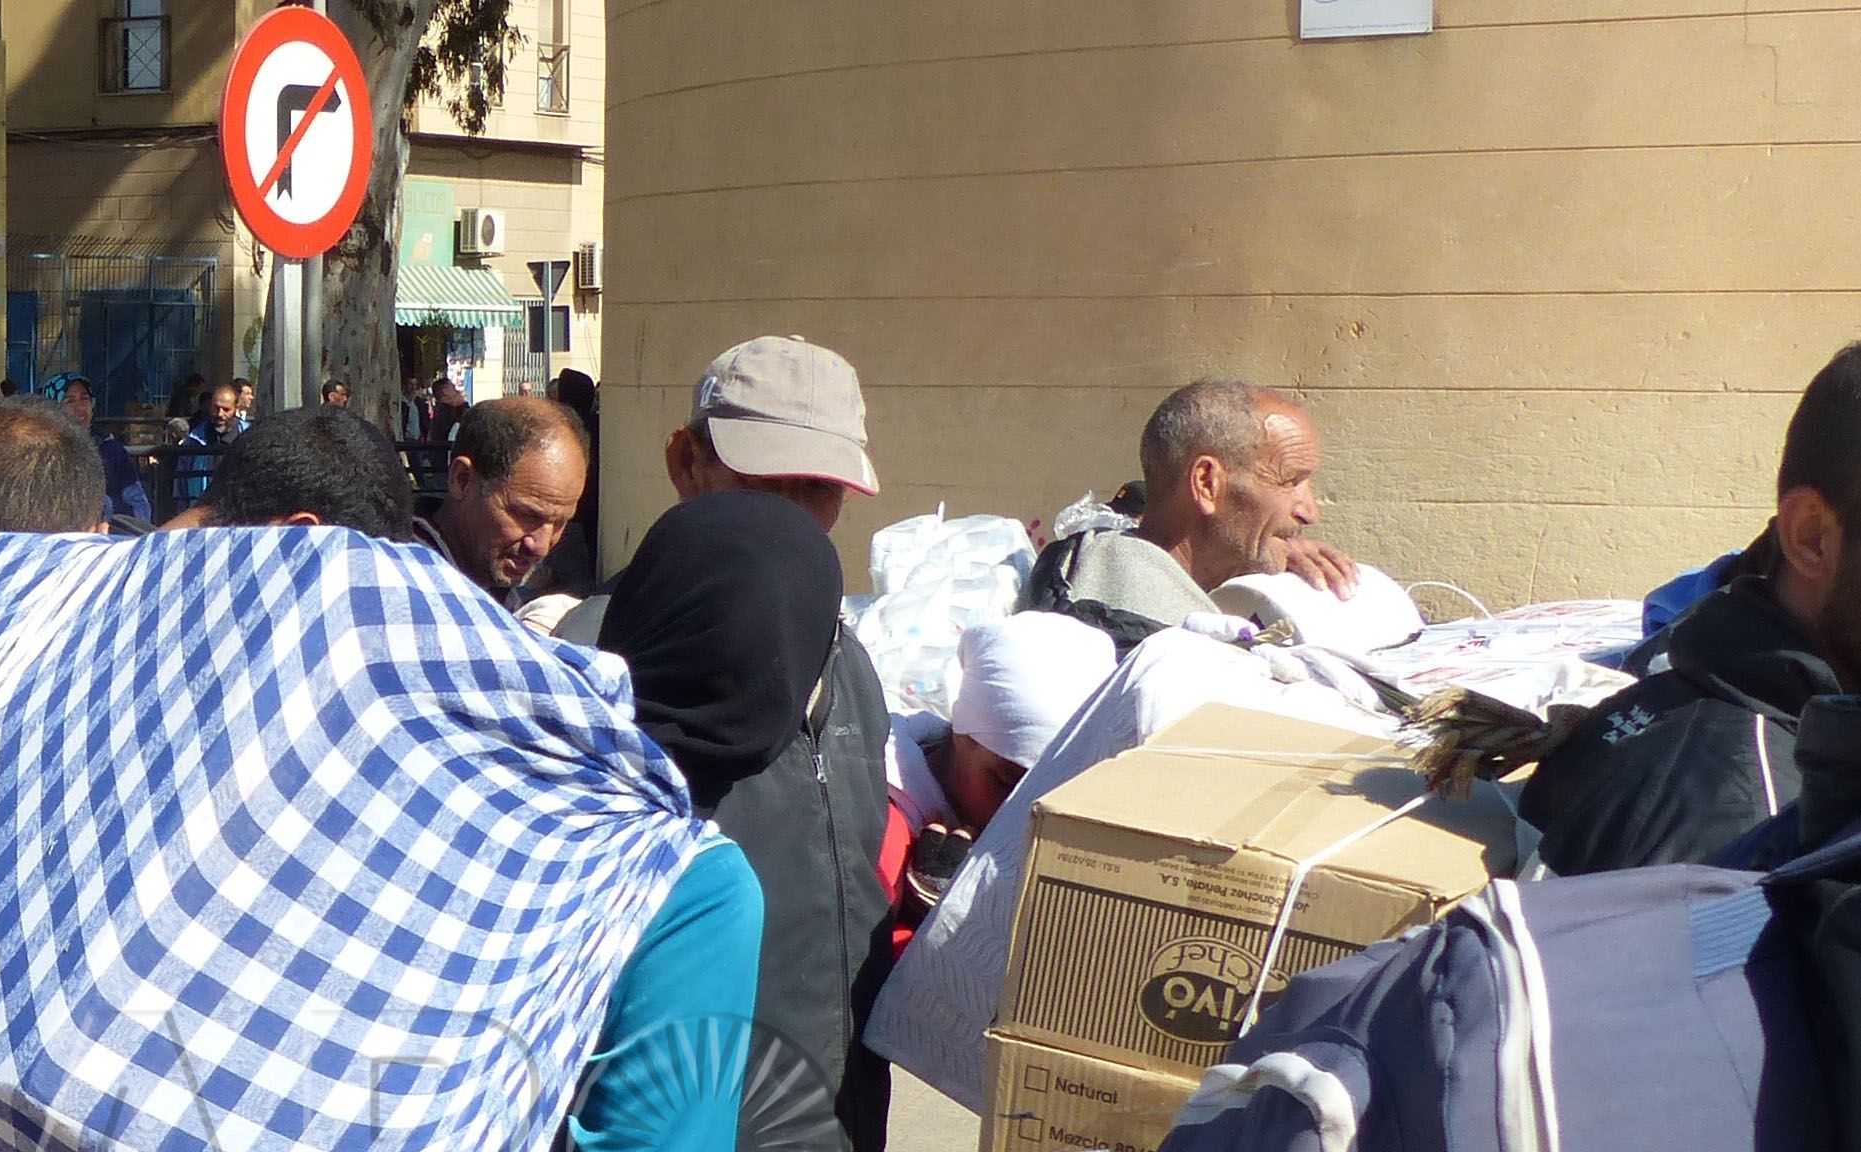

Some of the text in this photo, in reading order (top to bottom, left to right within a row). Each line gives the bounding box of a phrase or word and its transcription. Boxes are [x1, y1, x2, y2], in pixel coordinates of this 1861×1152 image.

[1166, 943, 1253, 984] Chef
[1054, 1076, 1119, 1104] Natural
[1048, 1126, 1109, 1151] Mezcla
